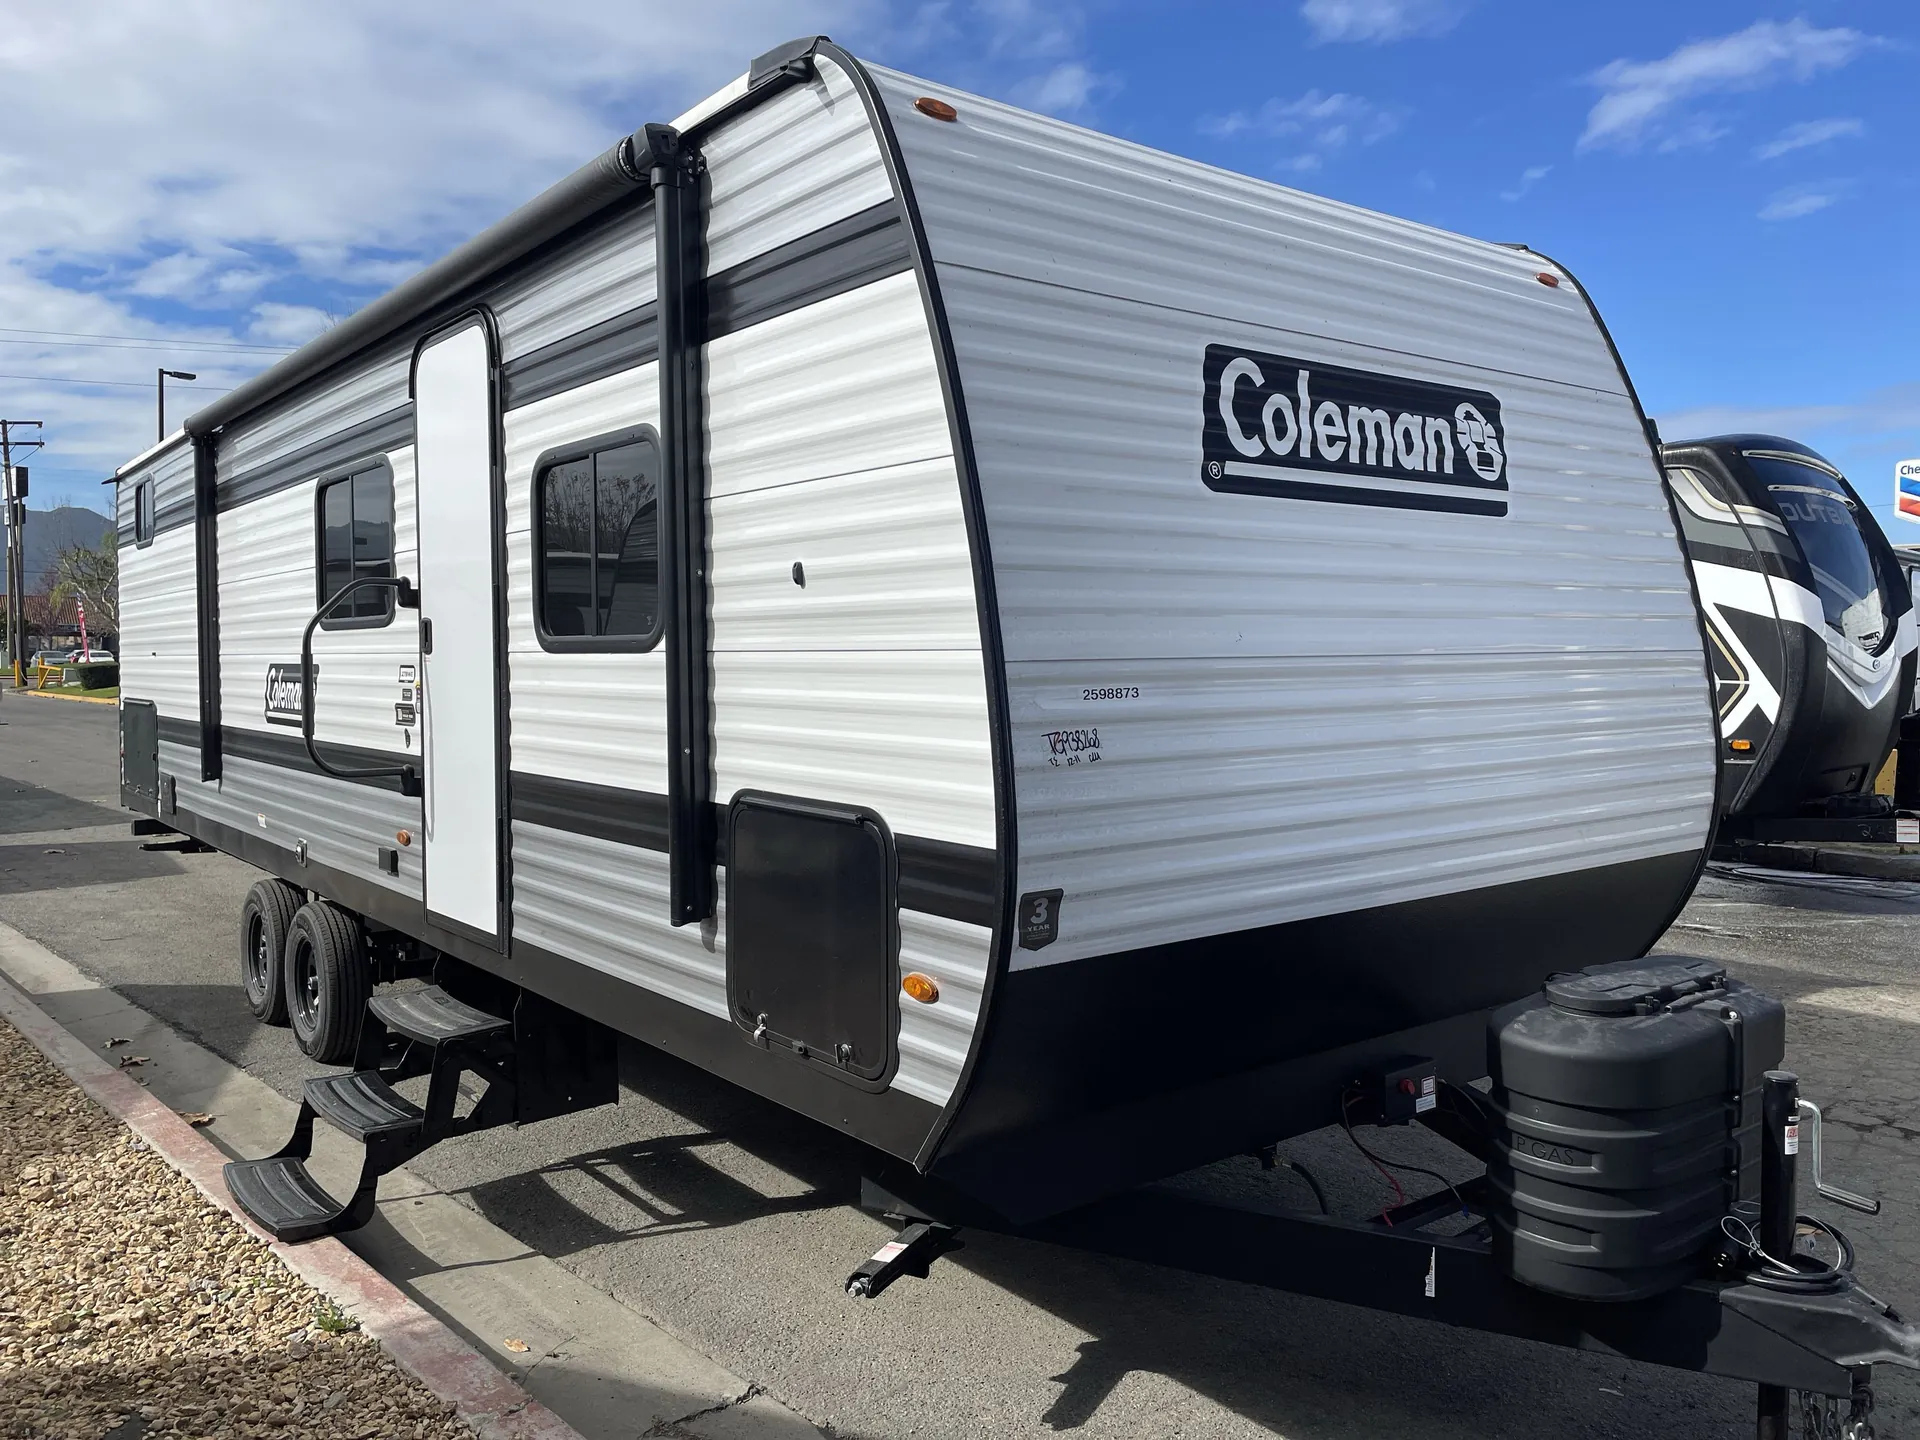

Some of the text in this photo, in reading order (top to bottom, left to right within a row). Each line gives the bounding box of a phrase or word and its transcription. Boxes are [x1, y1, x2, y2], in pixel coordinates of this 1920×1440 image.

[1218, 356, 1455, 474] Coleman
[1083, 687, 1140, 701] 2598873
[1030, 897, 1049, 924] 3
[1027, 923, 1050, 932] YEAR
[1531, 1141, 1574, 1165] GAS
